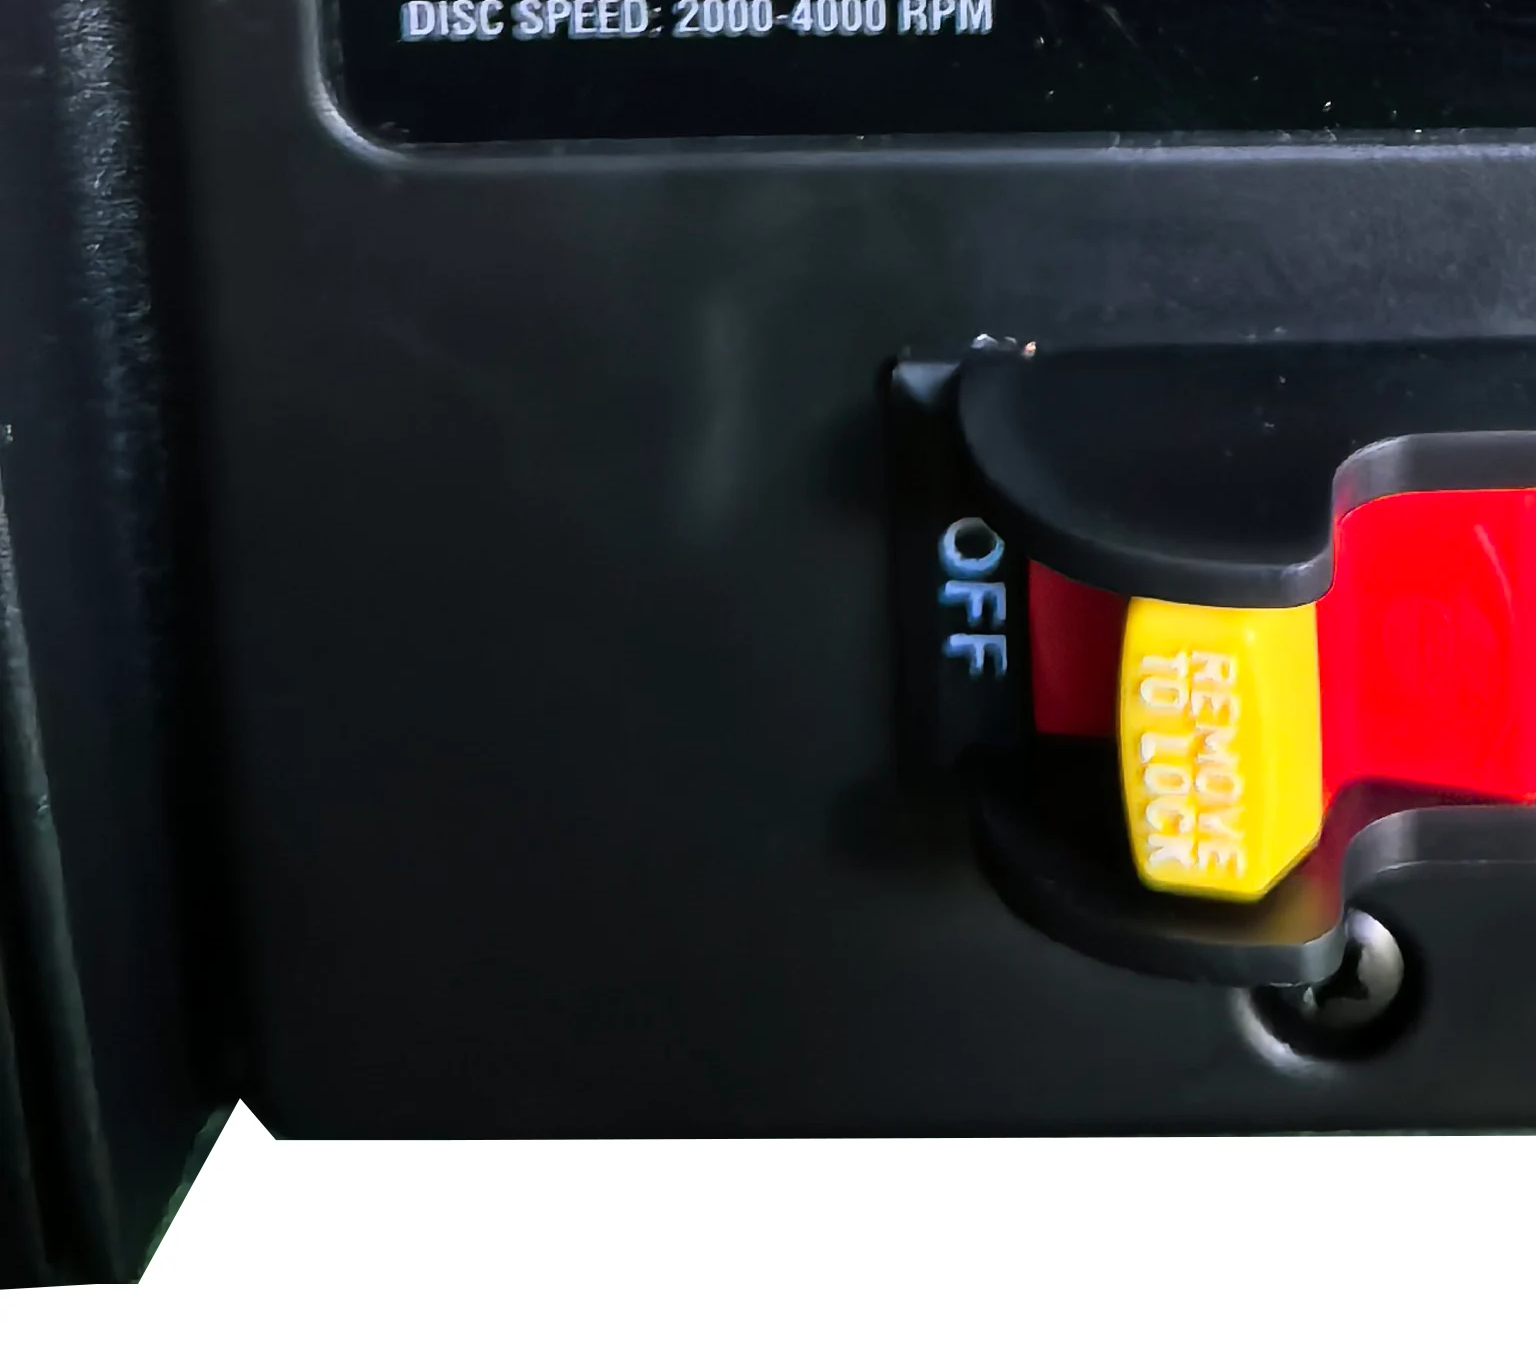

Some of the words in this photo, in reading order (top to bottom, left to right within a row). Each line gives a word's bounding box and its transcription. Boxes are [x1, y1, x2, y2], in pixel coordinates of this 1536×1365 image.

[401, 0, 504, 41] DISC
[511, 0, 662, 40] SPEED:
[937, 516, 1008, 676] OFF
[1139, 649, 1190, 713] TO
[1139, 732, 1196, 869] LOCK
[1190, 649, 1246, 877] REMOVE
